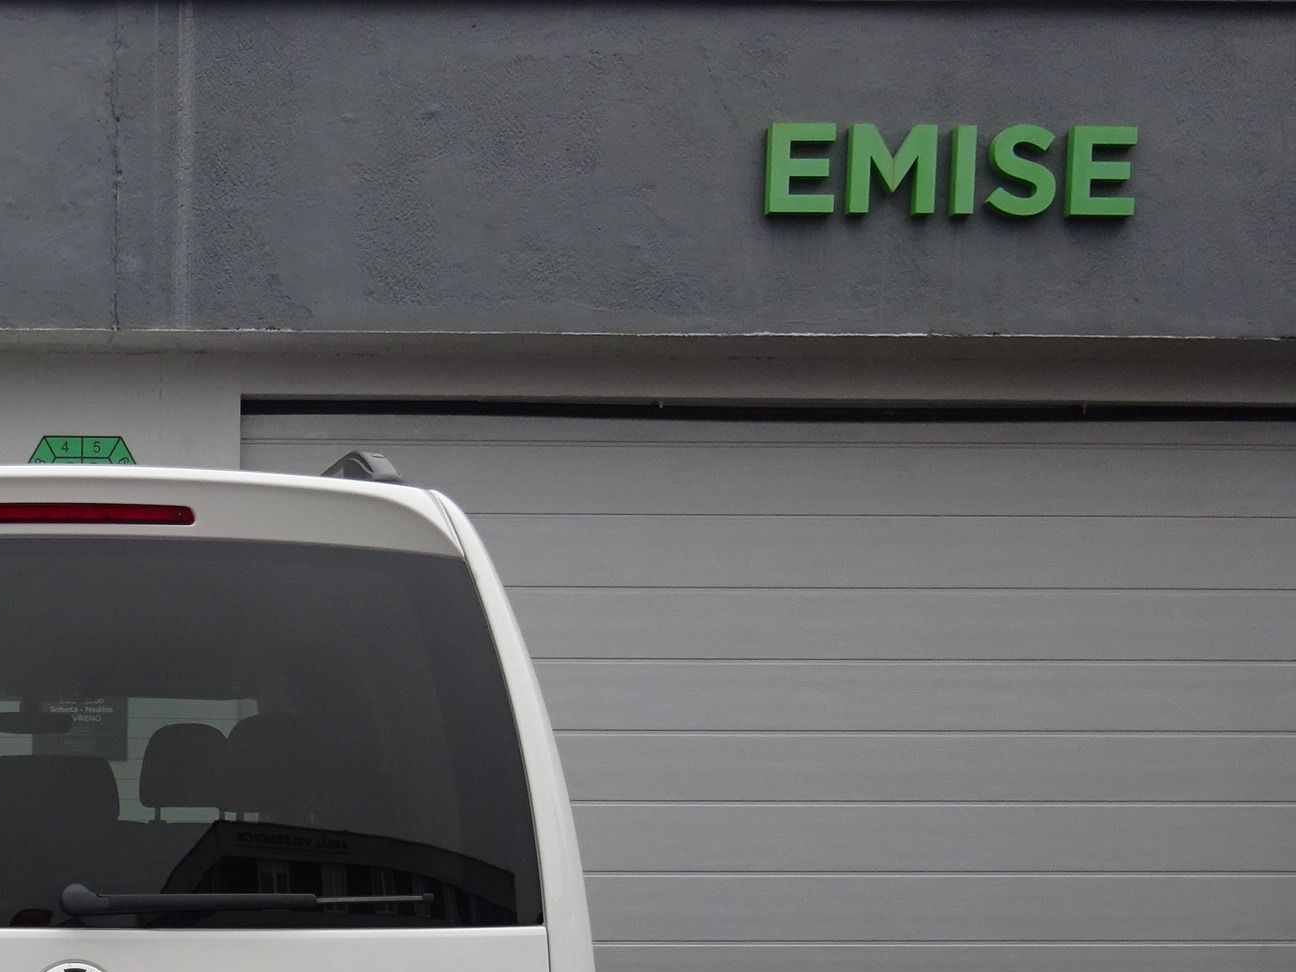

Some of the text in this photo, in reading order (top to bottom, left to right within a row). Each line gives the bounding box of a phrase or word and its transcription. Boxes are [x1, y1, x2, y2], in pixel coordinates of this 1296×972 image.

[764, 122, 1138, 217] EMISE
[61, 441, 69, 453] 4
[93, 441, 101, 453] 5
